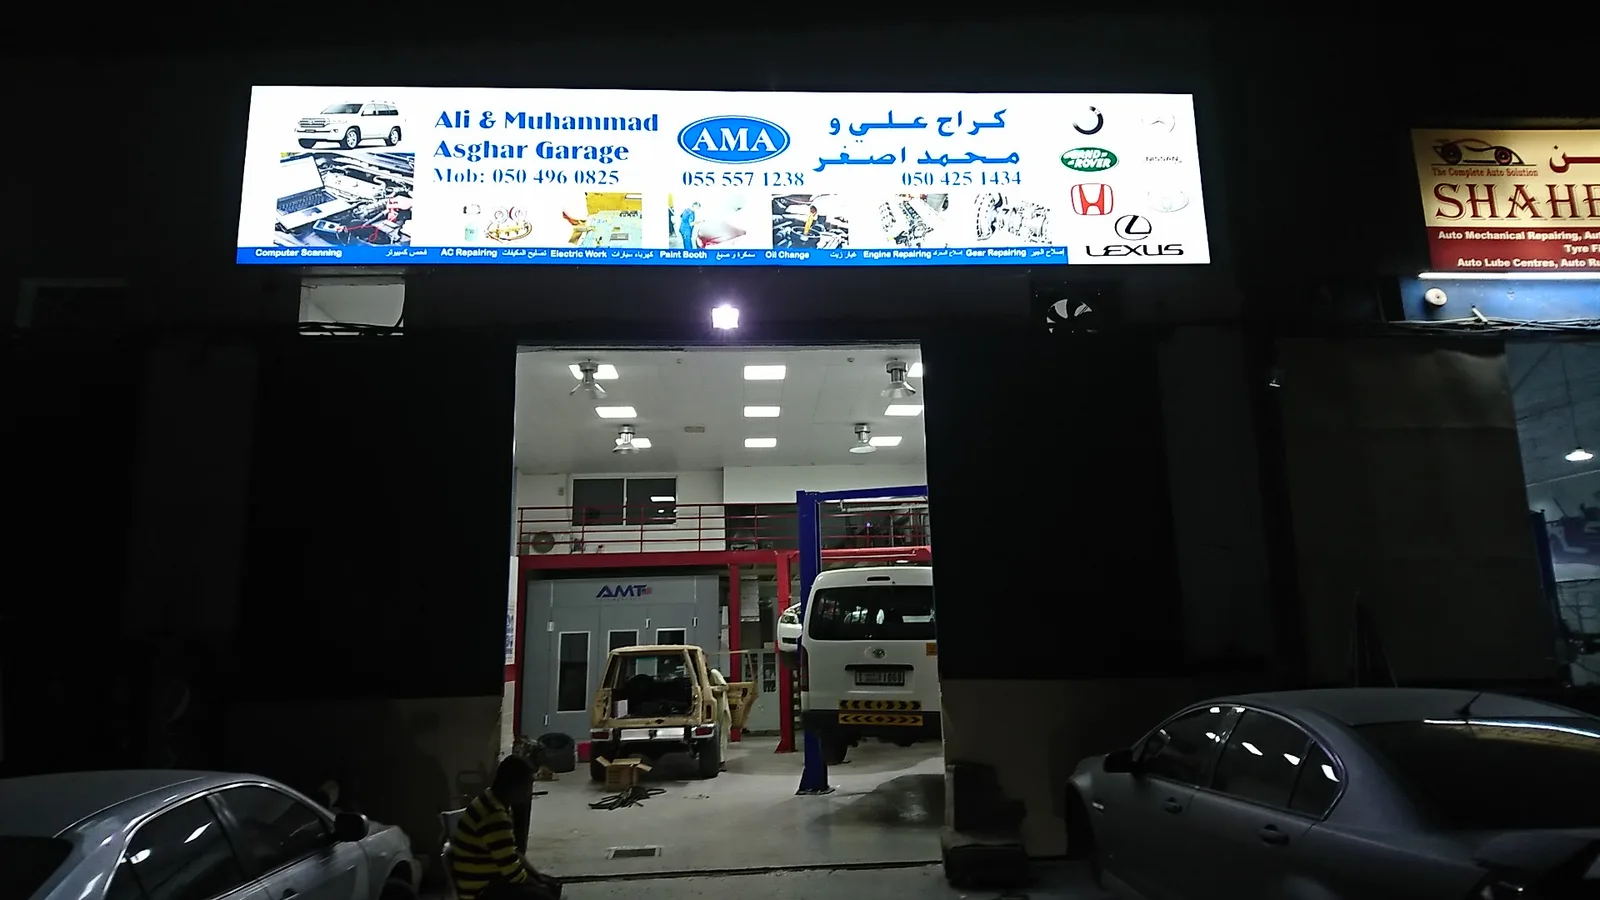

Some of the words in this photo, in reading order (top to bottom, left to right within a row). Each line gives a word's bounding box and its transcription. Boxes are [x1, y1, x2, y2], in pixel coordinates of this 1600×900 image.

[434, 110, 470, 129] Ali
[478, 111, 497, 129] &
[504, 111, 659, 132] Muhammad
[829, 117, 841, 136] و
[849, 110, 928, 143] علي
[936, 109, 1007, 137] كراج
[691, 127, 777, 152] AMA
[434, 140, 529, 163] Asghar
[536, 140, 630, 164] Garage
[917, 150, 1020, 167] محمد
[1074, 158, 1112, 168] ROVER
[434, 168, 485, 183] Mob:
[492, 169, 527, 183] 050
[533, 170, 568, 184] 496
[574, 171, 620, 185] 0825
[901, 172, 934, 186] 050
[941, 172, 973, 186] 425
[981, 171, 1022, 185] 1434
[1432, 167, 1447, 176] The
[1450, 167, 1484, 178] Complete
[1486, 167, 1504, 176] Auto
[1506, 167, 1538, 177] Solution
[682, 172, 715, 186] 055
[722, 172, 754, 186] 557
[763, 172, 804, 187] 1238
[1438, 231, 1463, 240] Auto
[1465, 231, 1526, 241] Mechanical
[1527, 231, 1583, 242] Repairing,
[255, 249, 299, 258] Computer
[301, 248, 343, 258] Scanning
[440, 248, 455, 257] AC
[456, 248, 498, 258] Repairing
[551, 250, 583, 258] Electric
[584, 250, 607, 258] Work
[660, 250, 681, 259] Paint
[683, 250, 707, 259] Booth
[765, 250, 777, 259] Oil
[778, 250, 810, 260] Change
[863, 250, 892, 260] Engine
[893, 250, 932, 260] Repairing
[966, 249, 985, 257] Gear
[988, 248, 1027, 258] Repairing
[1086, 244, 1184, 257] LEXUS
[1564, 244, 1589, 254] Tyre
[1457, 258, 1482, 267] Auto
[1484, 258, 1511, 267] Lube
[1512, 258, 1559, 269] Centres,
[1561, 258, 1586, 267] Auto
[596, 584, 647, 598] AMT
